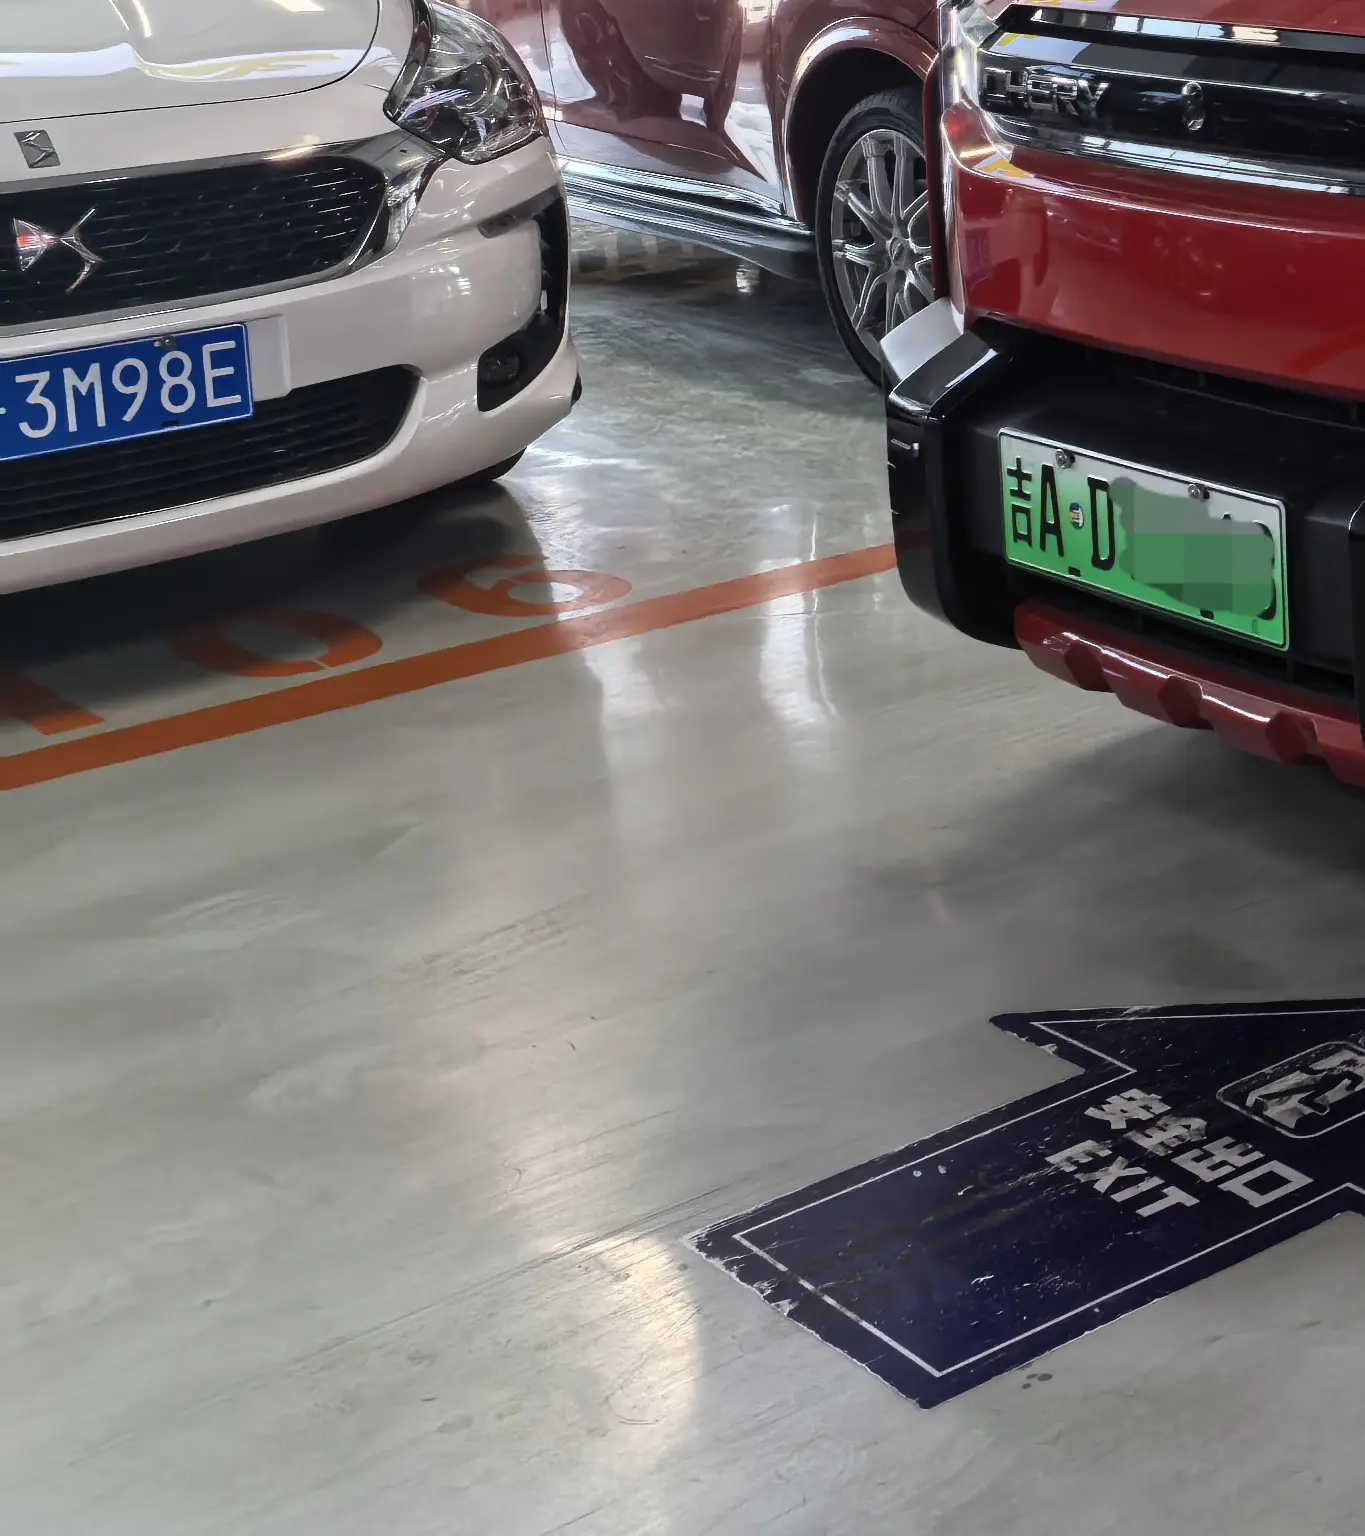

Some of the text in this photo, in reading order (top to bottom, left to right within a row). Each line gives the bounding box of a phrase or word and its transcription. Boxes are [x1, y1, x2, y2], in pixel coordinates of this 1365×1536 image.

[15, 340, 242, 439] 3M98E
[1044, 1139, 1200, 1218] EXIT
[1084, 1088, 1315, 1209] 安全出口
